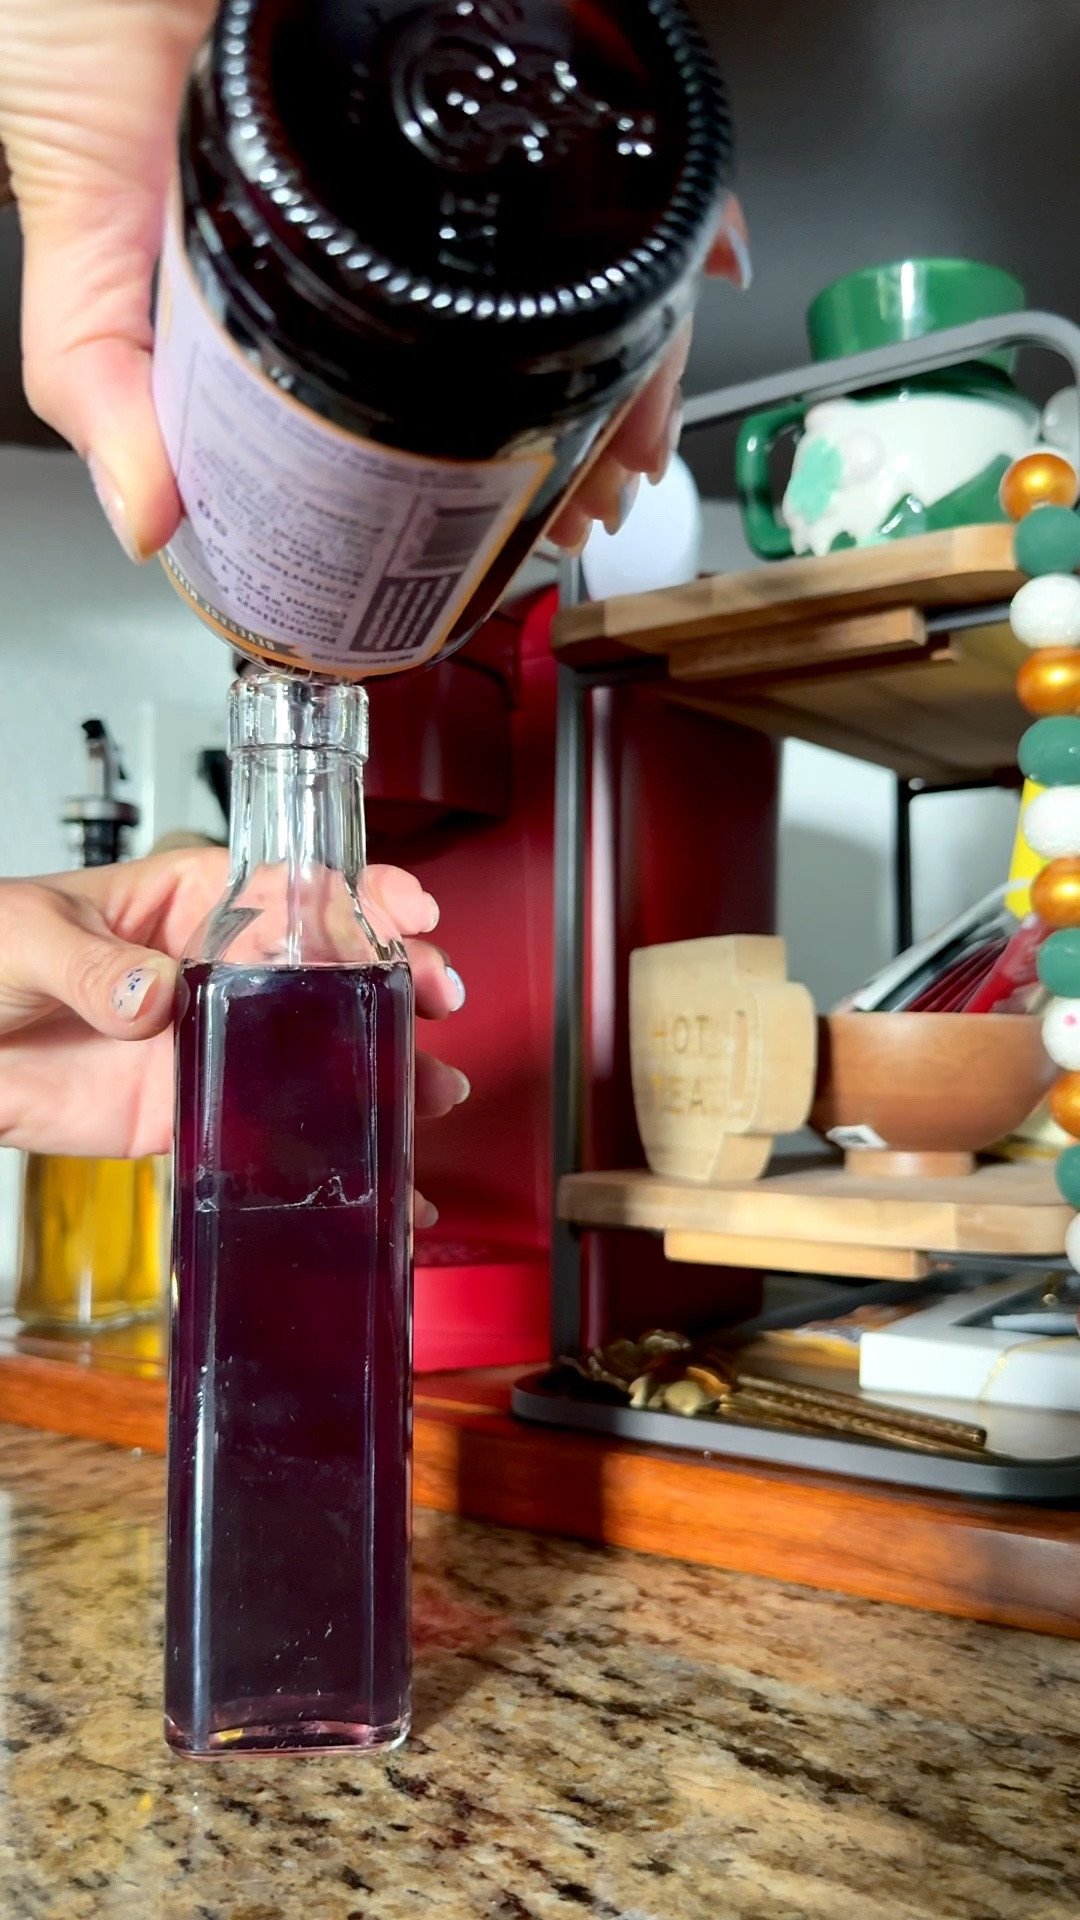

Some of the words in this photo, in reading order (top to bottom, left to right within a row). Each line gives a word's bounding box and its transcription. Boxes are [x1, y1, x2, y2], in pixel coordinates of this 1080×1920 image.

[204, 602, 275, 651] BEVERAGE
[651, 1014, 710, 1056] HOT
[651, 1074, 707, 1116] TEA
